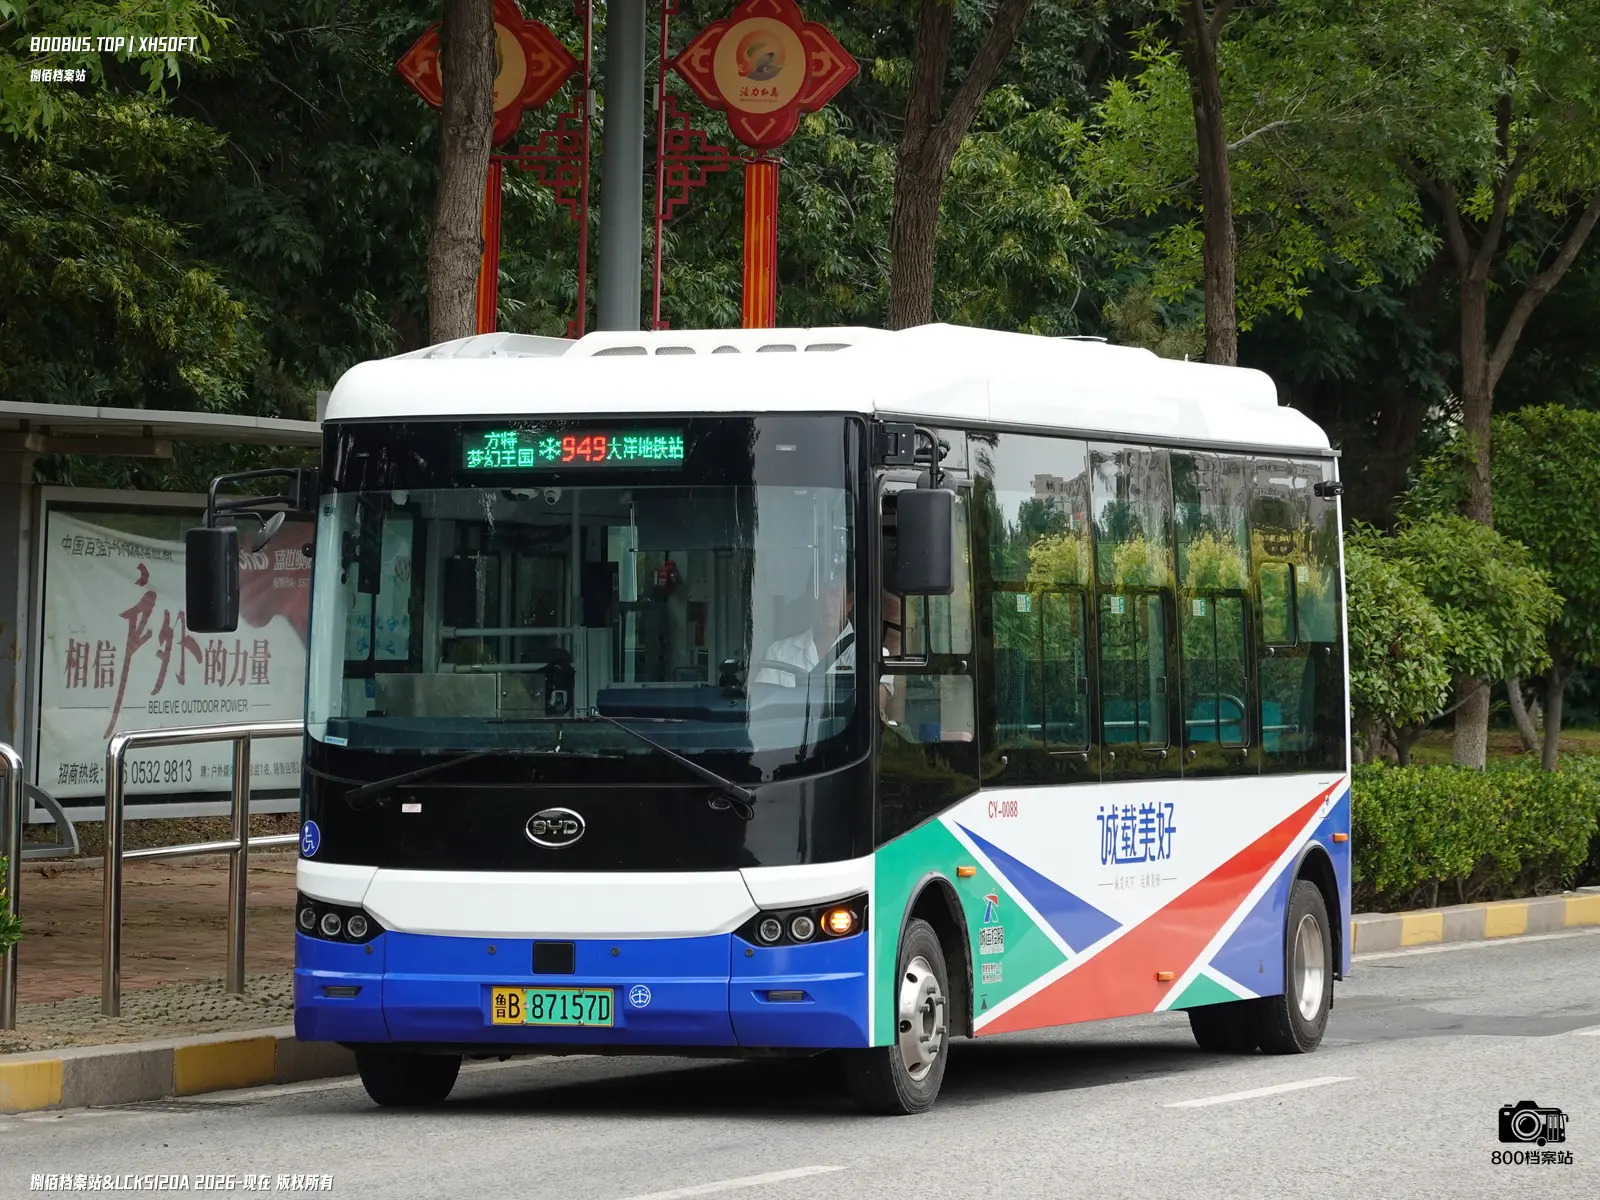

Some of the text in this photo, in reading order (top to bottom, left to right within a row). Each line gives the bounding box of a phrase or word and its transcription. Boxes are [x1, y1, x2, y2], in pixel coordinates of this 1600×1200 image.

[484, 431, 518, 450] 方特
[561, 436, 606, 462] 949
[606, 436, 684, 460] 大洋地铁站
[467, 449, 534, 468] 梦幻王国
[148, 699, 248, 714] BELIEVE OUTDOOR POWER
[131, 760, 161, 784] 0532
[163, 759, 193, 783] 9813
[987, 801, 1019, 818] CY-0088
[532, 820, 579, 835] BYD
[1096, 801, 1177, 866] 诚载美好
